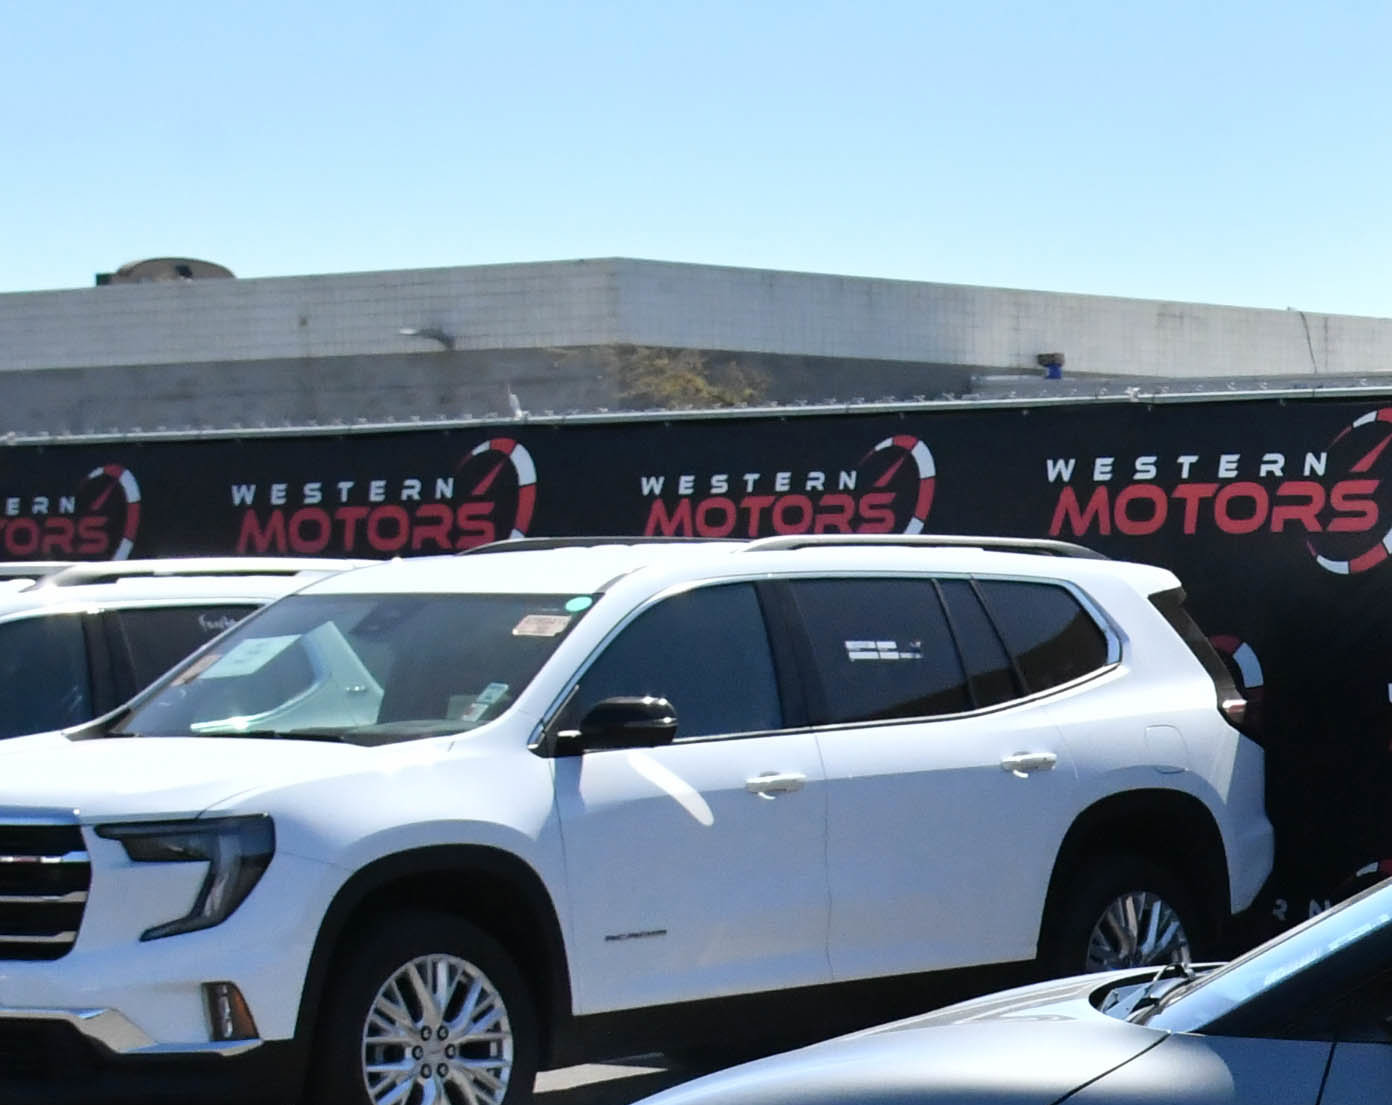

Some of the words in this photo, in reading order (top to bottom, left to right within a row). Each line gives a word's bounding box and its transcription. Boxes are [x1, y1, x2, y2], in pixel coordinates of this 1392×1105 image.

[641, 470, 857, 496] WESTERN
[1046, 451, 1328, 483] WESTERN
[6, 496, 75, 516] ERN
[231, 477, 454, 506] WESTERN
[1047, 479, 1381, 537] MOTORS
[236, 501, 495, 554] MOTORS
[644, 491, 897, 538] MOTORS
[0, 516, 108, 555] ORS
